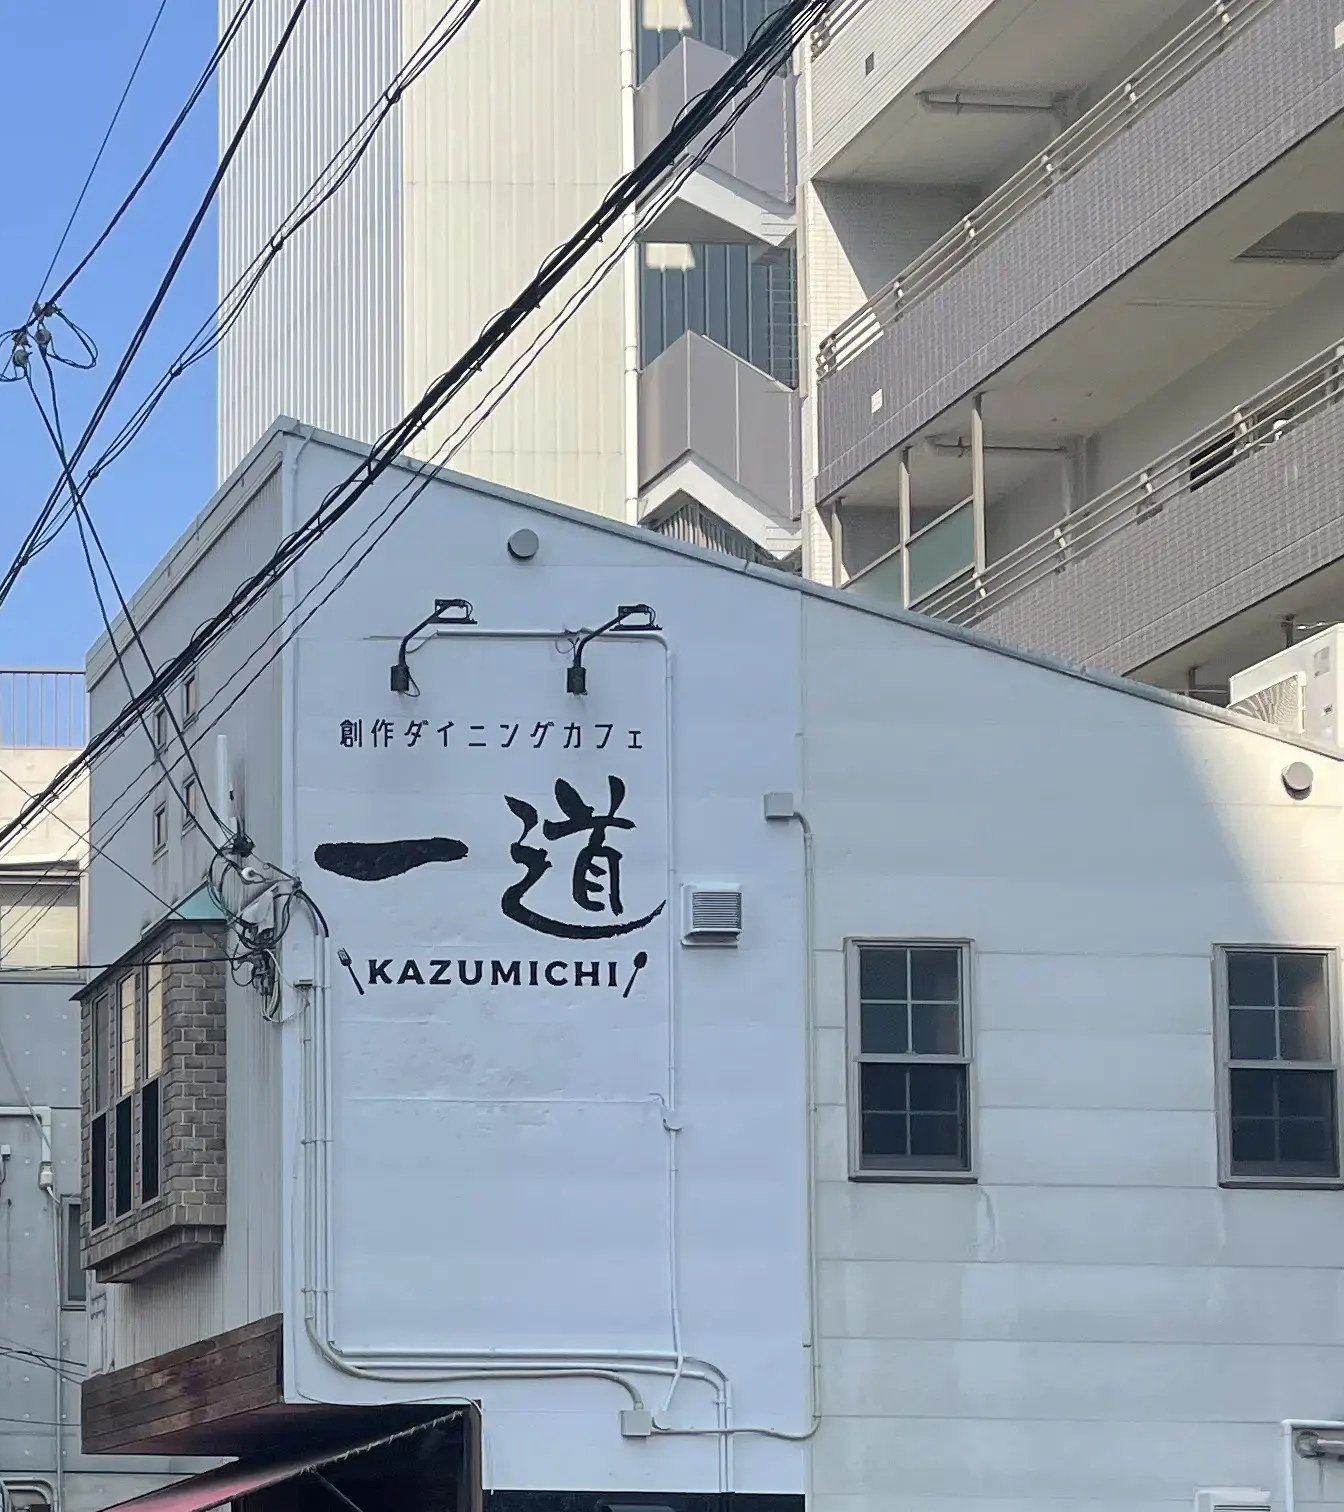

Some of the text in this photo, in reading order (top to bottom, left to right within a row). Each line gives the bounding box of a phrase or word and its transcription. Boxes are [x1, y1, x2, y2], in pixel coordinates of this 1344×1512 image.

[339, 718, 643, 750] 創作ダイニングカフェ
[313, 774, 667, 940] 一道
[367, 958, 618, 988] KAZUMICHI
